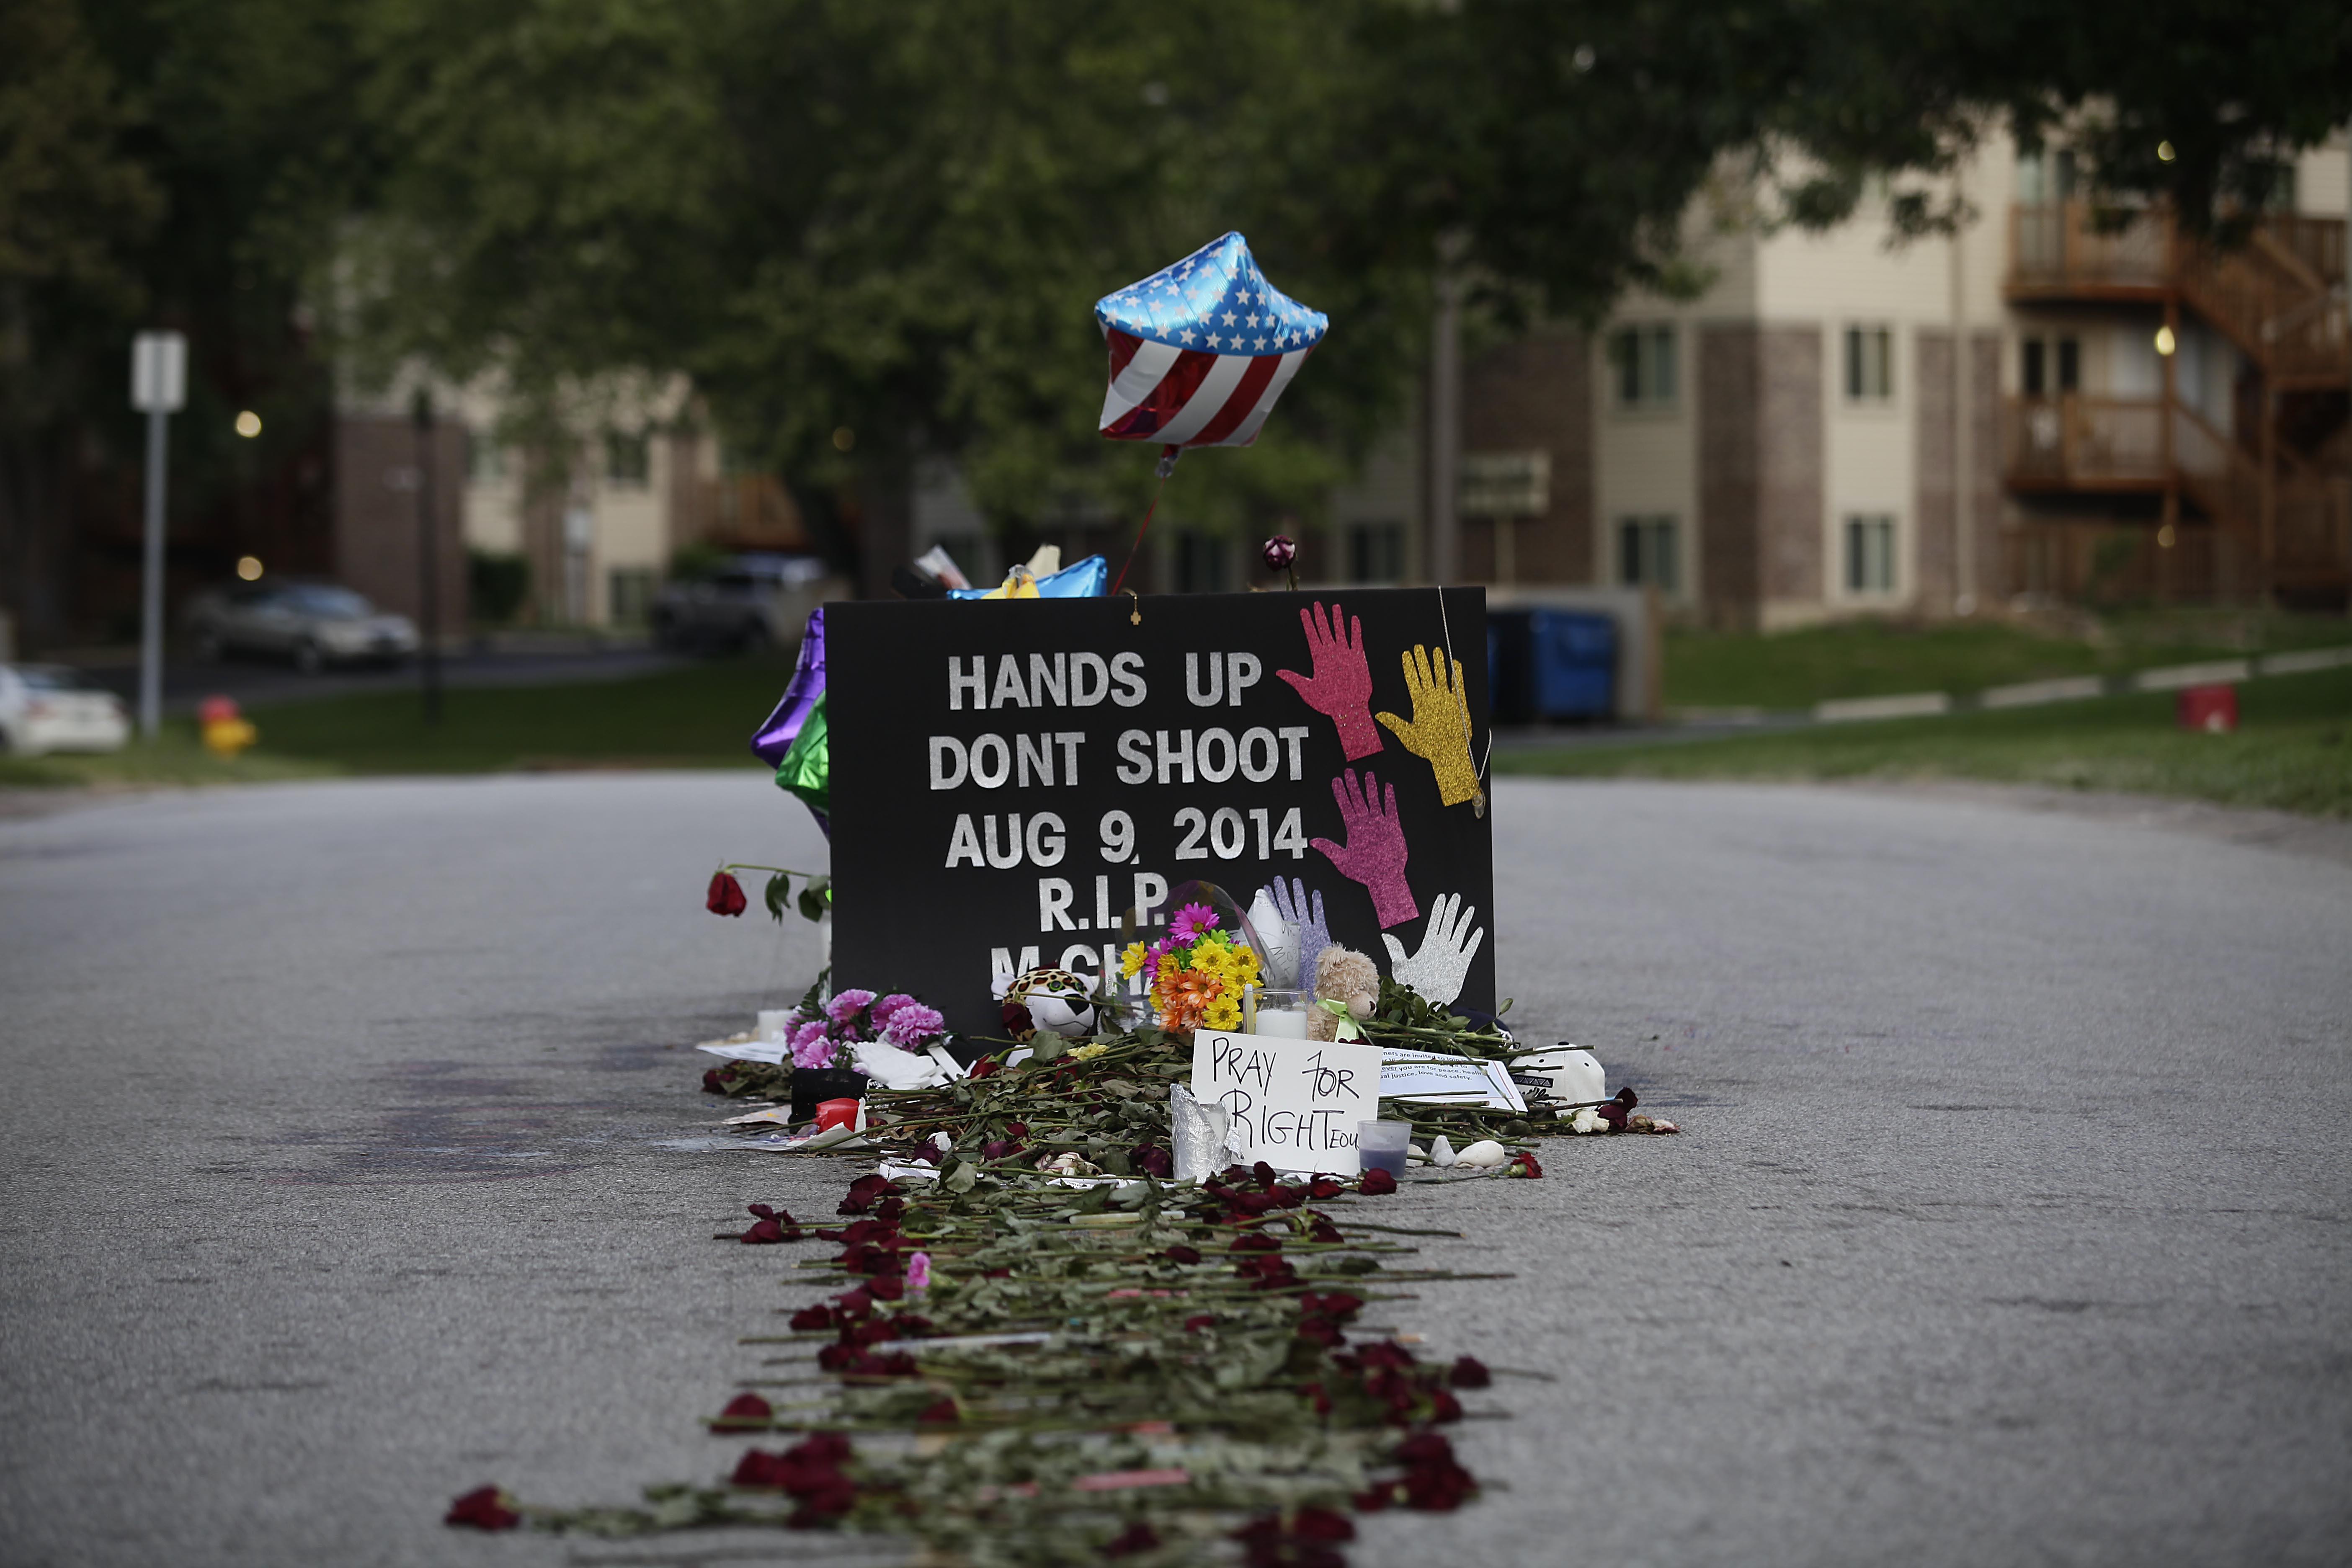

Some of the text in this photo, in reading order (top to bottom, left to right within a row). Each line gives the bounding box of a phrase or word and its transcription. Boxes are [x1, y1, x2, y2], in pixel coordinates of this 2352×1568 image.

[949, 652, 1262, 710] HANDS UP
[929, 726, 1309, 790] DONT SHOOT
[945, 807, 1308, 869] AUG 9, 2014
[1039, 872, 1168, 932] R.I.P.
[1212, 1037, 1359, 1102] PRAY FOR
[1220, 1088, 1359, 1151] RIGHTEOU
